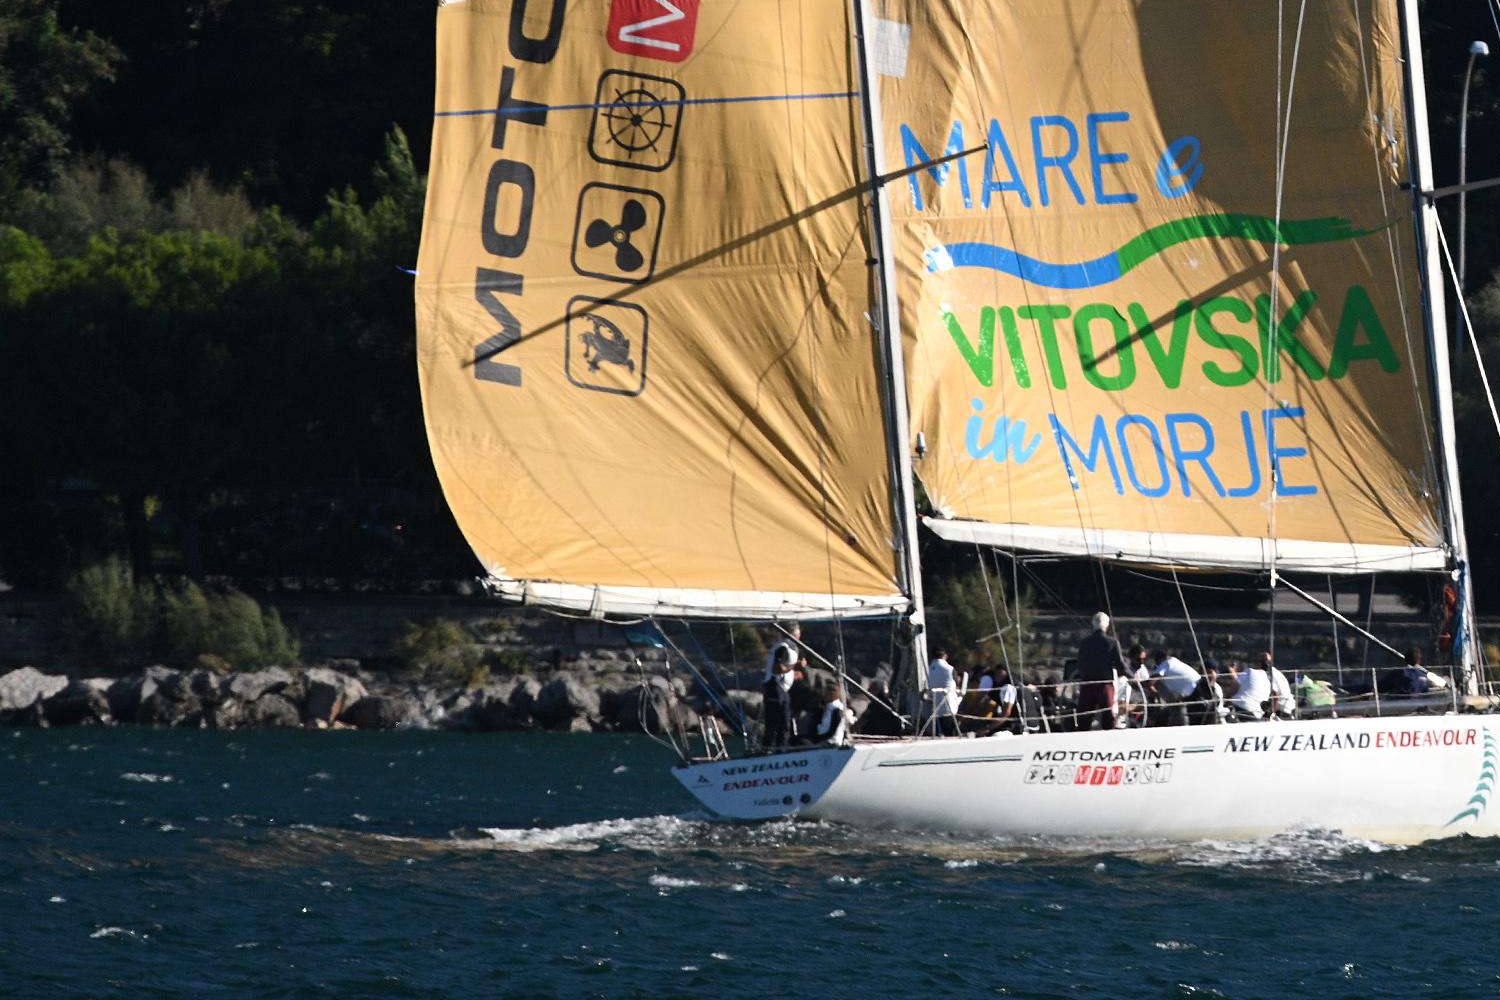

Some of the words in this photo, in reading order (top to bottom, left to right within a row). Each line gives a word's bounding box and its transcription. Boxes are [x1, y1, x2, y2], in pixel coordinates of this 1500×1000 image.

[899, 111, 1139, 211] MARE
[1155, 136, 1204, 198] e
[938, 285, 1400, 391] VITOVSKA
[963, 398, 1042, 464] in
[1048, 407, 1318, 498] MORJE
[1032, 747, 1177, 762] MOTOMARINE
[1223, 735, 1274, 753] NEW
[1278, 732, 1371, 752] ZEALAND
[1375, 728, 1478, 749] ENDEAVOUR
[723, 773, 810, 791] ENDEAVOUR
